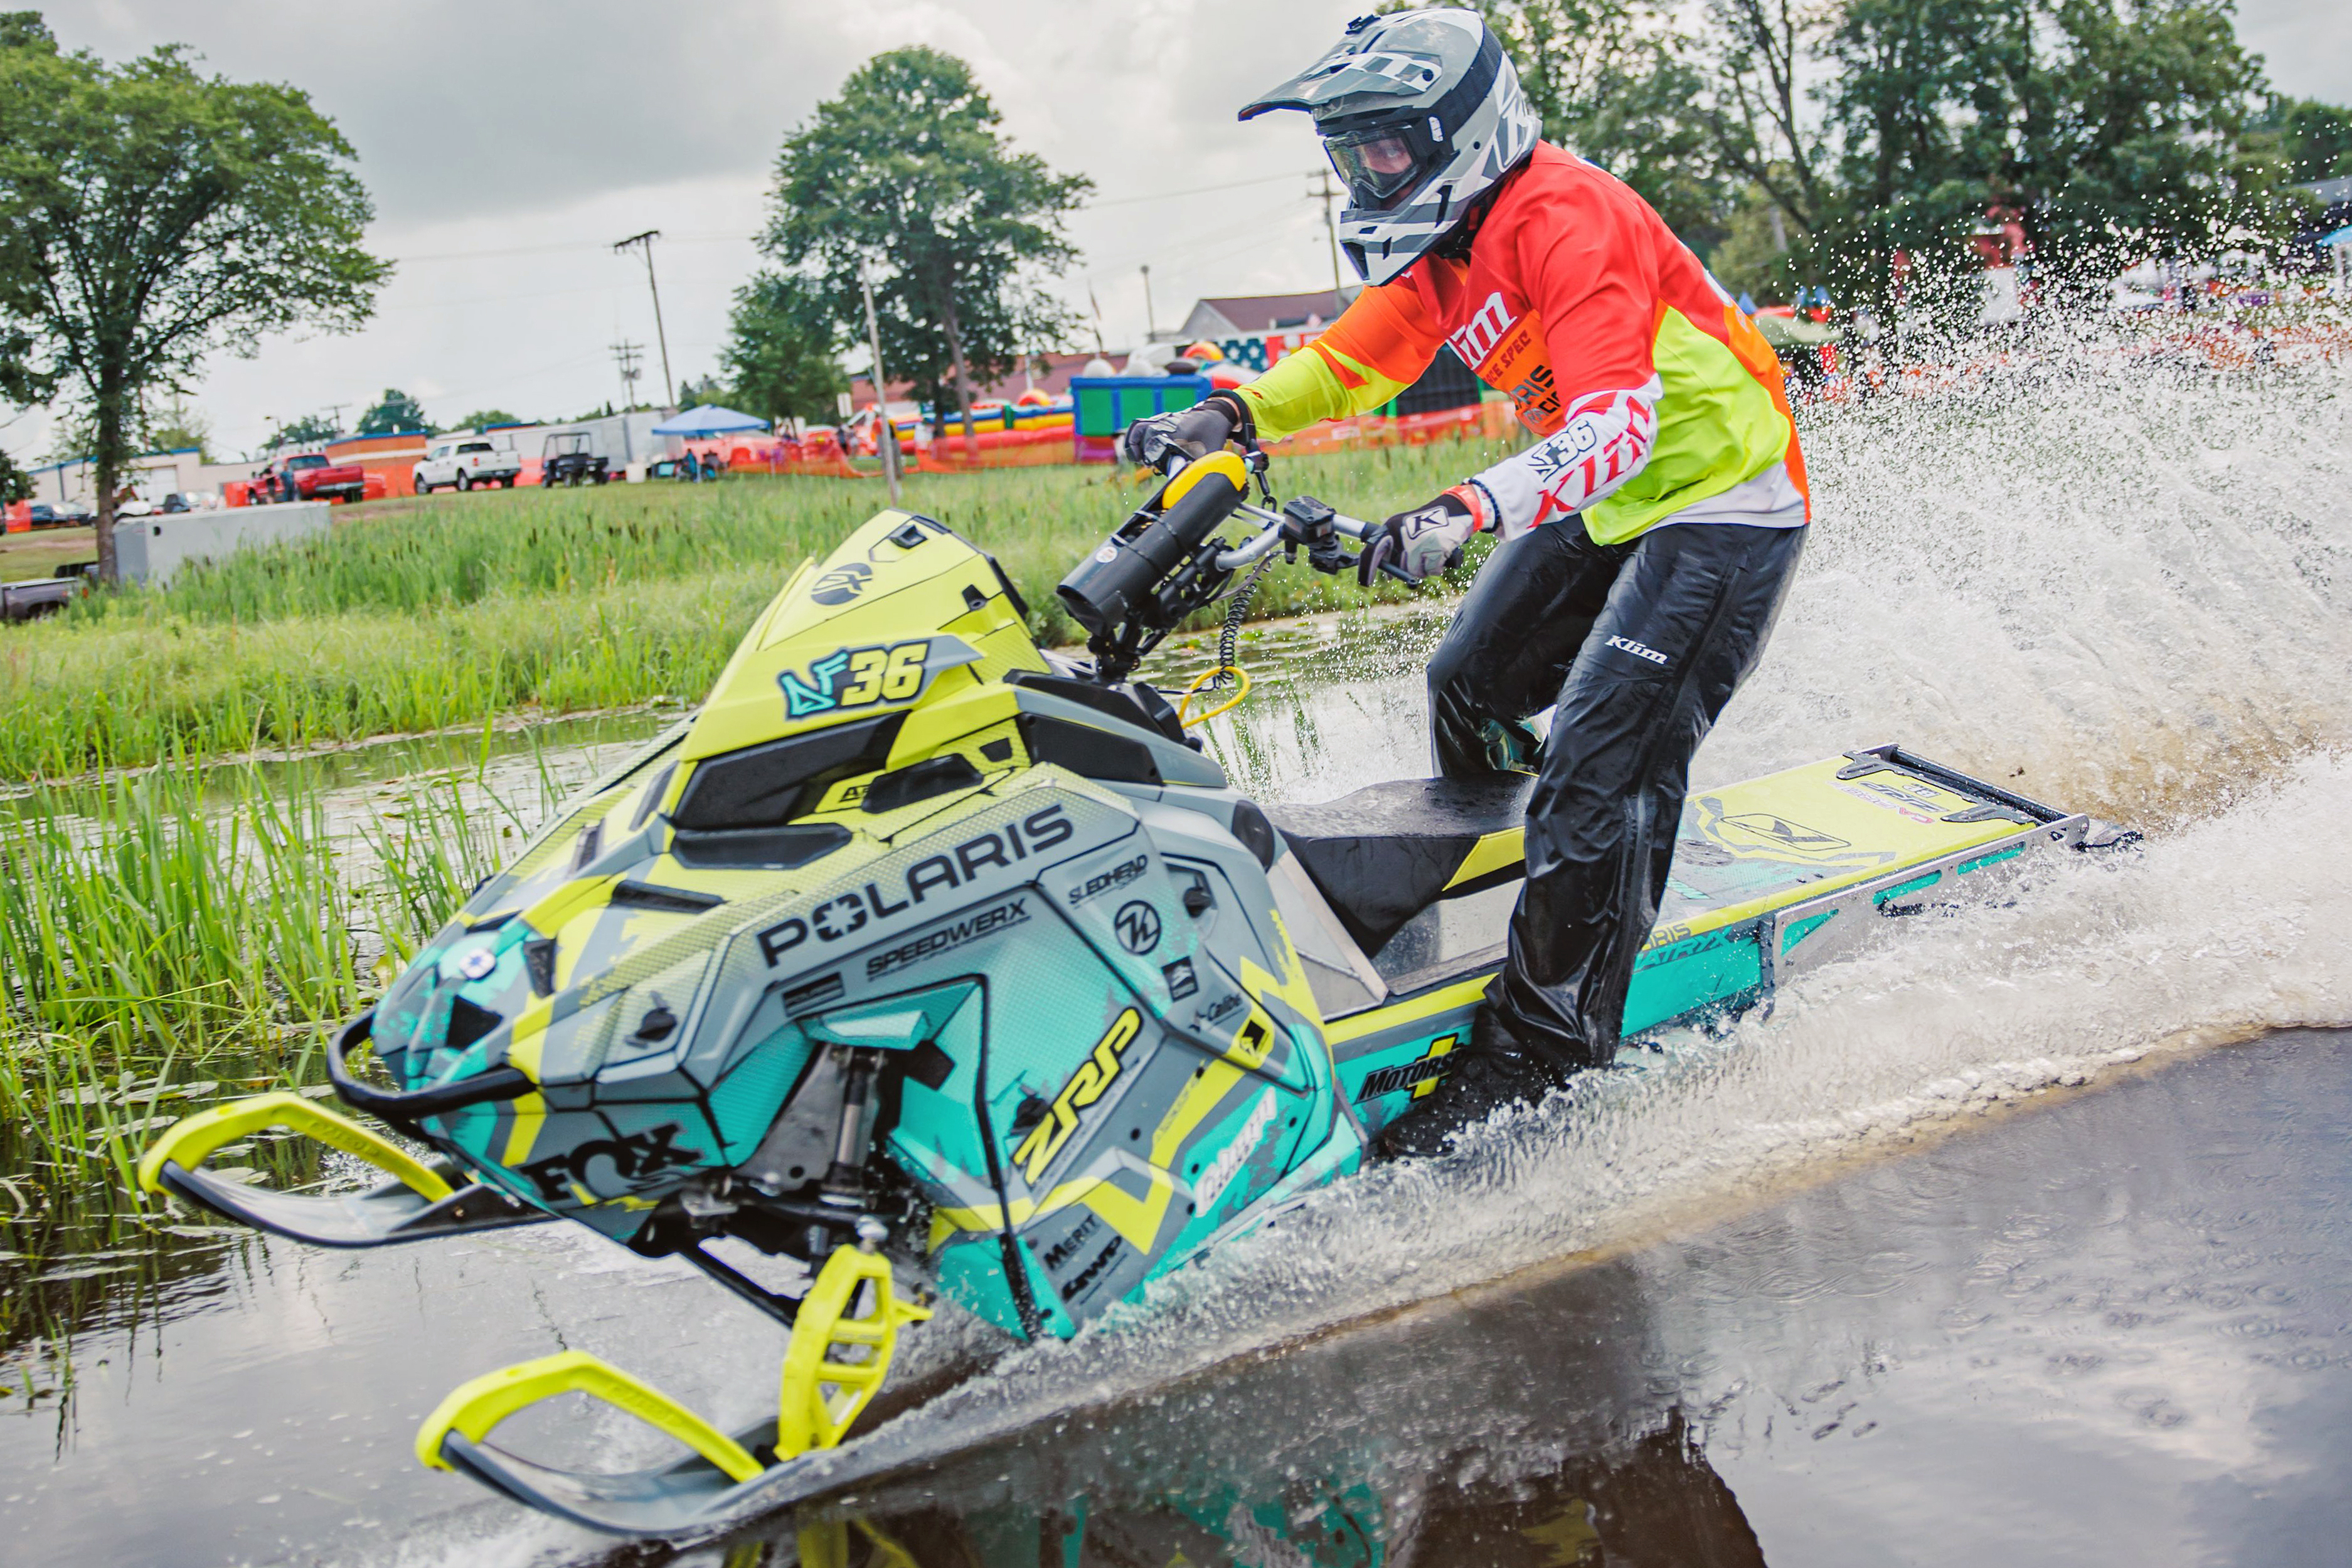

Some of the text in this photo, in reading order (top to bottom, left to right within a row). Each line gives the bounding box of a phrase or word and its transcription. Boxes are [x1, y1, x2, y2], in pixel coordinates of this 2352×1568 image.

[1500, 329, 1532, 369] SPEC
[1604, 635, 1668, 665] Klim
[756, 803, 1073, 969] POLARIS
[866, 898, 1028, 977] SPEEDWERX
[1012, 1005, 1144, 1189] ZRP
[519, 1124, 701, 1202] FOX
